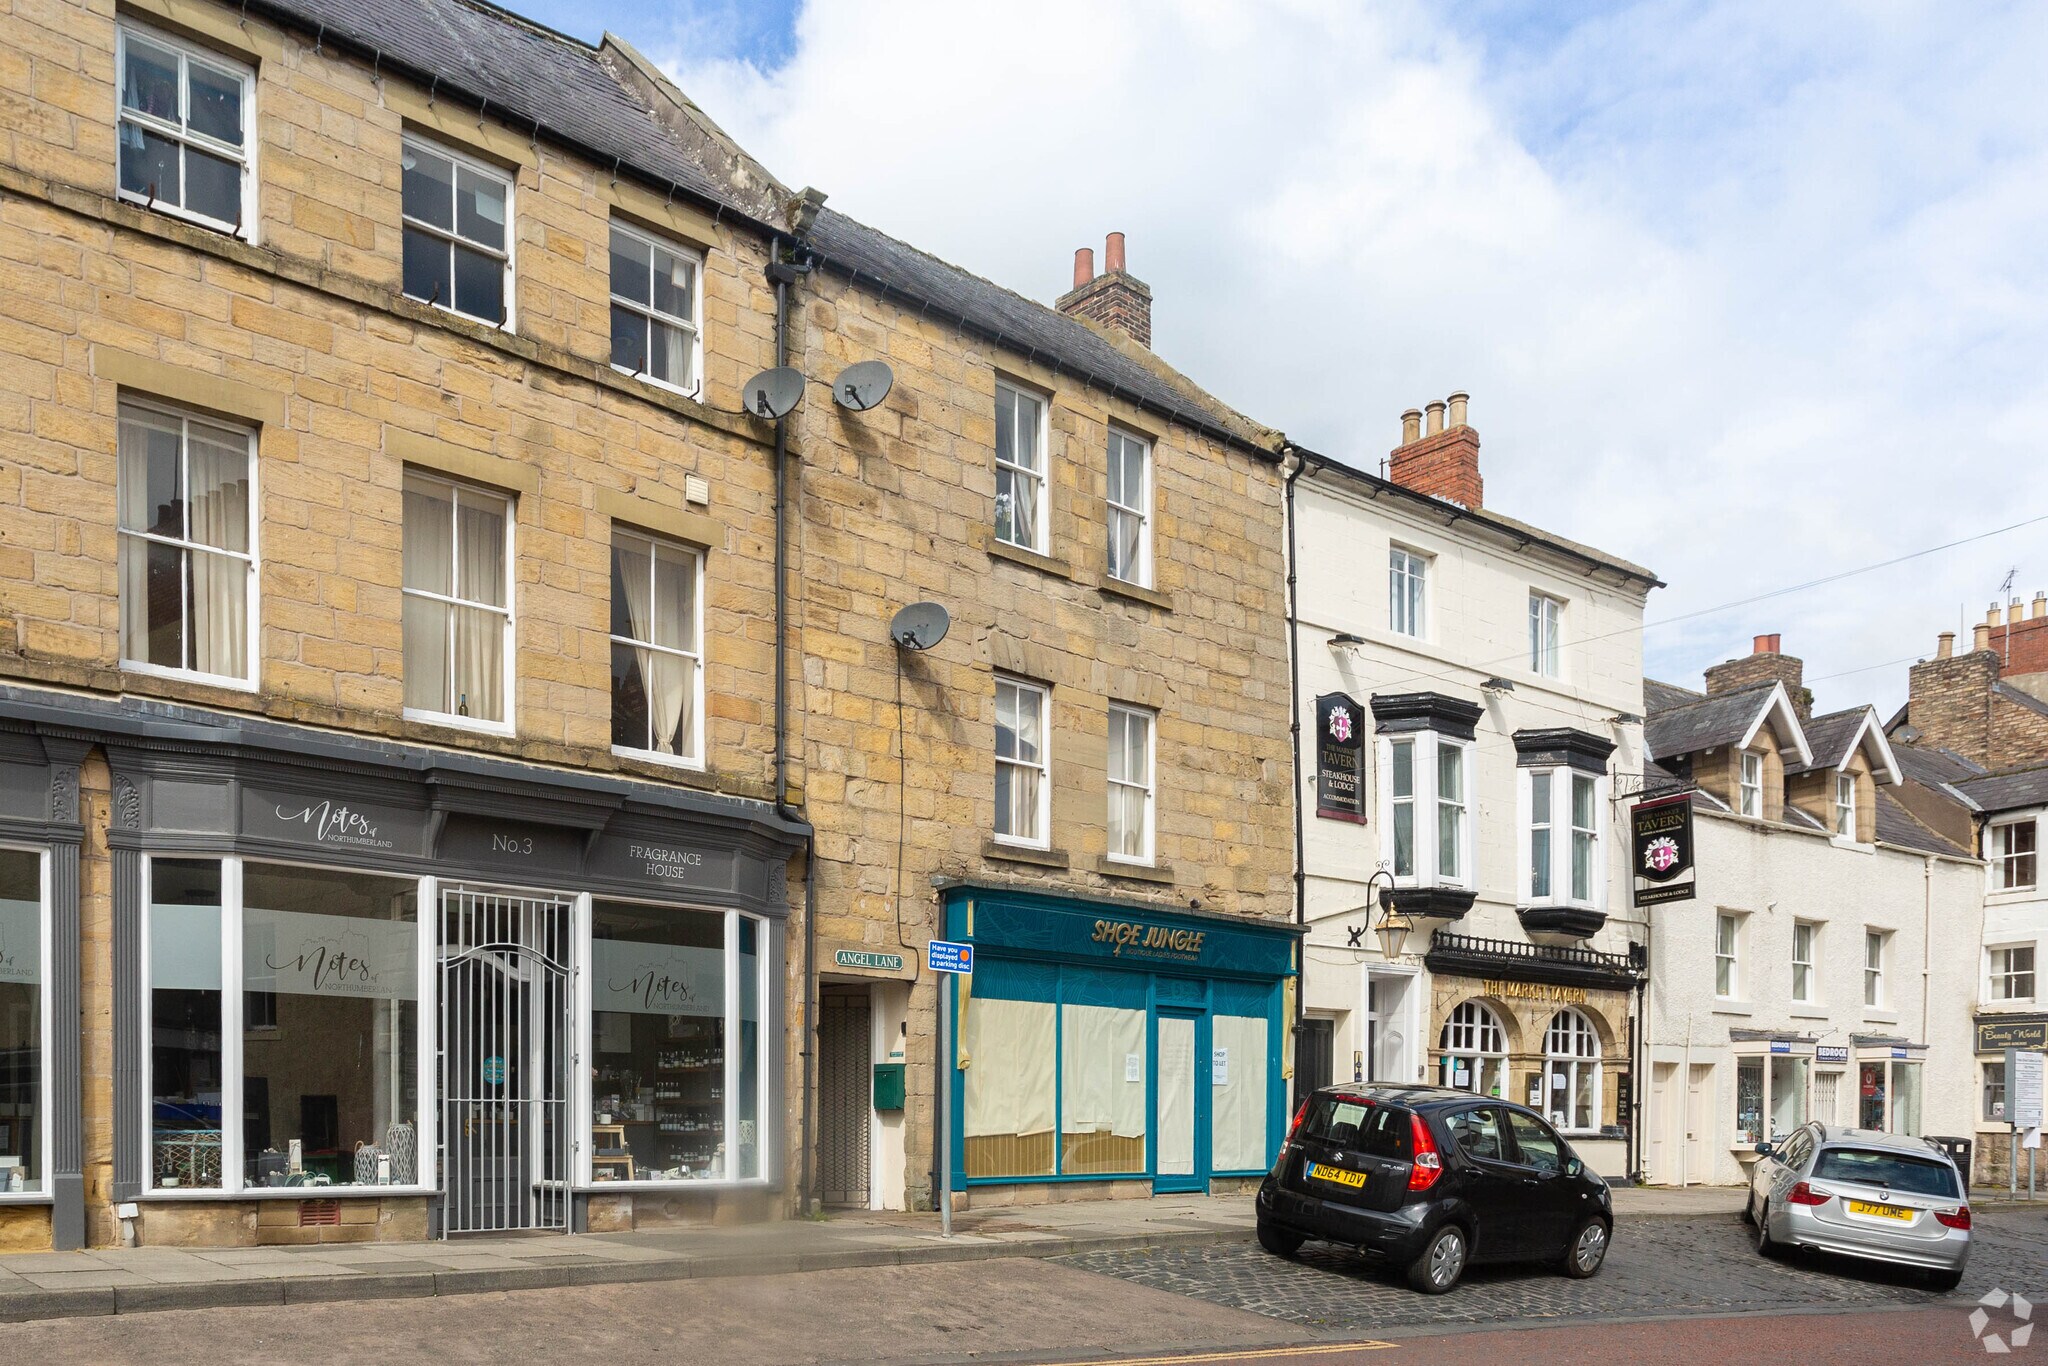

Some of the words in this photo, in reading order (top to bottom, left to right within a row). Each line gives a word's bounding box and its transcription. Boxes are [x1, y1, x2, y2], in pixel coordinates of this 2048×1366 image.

[1322, 751, 1359, 769] TAVERN
[1322, 769, 1360, 784] STEAKHOUSE
[1328, 780, 1334, 788] &
[1335, 781, 1355, 791] LODGE
[276, 801, 370, 840] Notes
[1637, 813, 1685, 831] TAVERN
[327, 834, 392, 848] NORTHUMBERLAND
[492, 833, 533, 855] No.3
[630, 845, 702, 866] FRAGRANCE
[646, 863, 685, 879] HOUSE
[1091, 920, 1143, 957] SHOE
[1142, 926, 1205, 952] JUNGLE
[931, 944, 947, 952] Have
[840, 952, 872, 966] ANGEL
[875, 956, 900, 968] LANE
[931, 952, 958, 961] displayed
[936, 960, 957, 969] parking
[266, 946, 370, 990] Notes
[608, 971, 689, 1010] Notes
[1484, 980, 1504, 995] THE
[1507, 982, 1547, 999] MARKET
[1550, 985, 1587, 1003] TAVERN
[1984, 1030, 2012, 1040] Beauty
[2013, 1029, 2042, 1038] World
[1818, 1047, 1847, 1057] BEDROCK
[1313, 1165, 1340, 1180] ND64
[1343, 1171, 1364, 1185] TDV
[1858, 1202, 1880, 1214] J77
